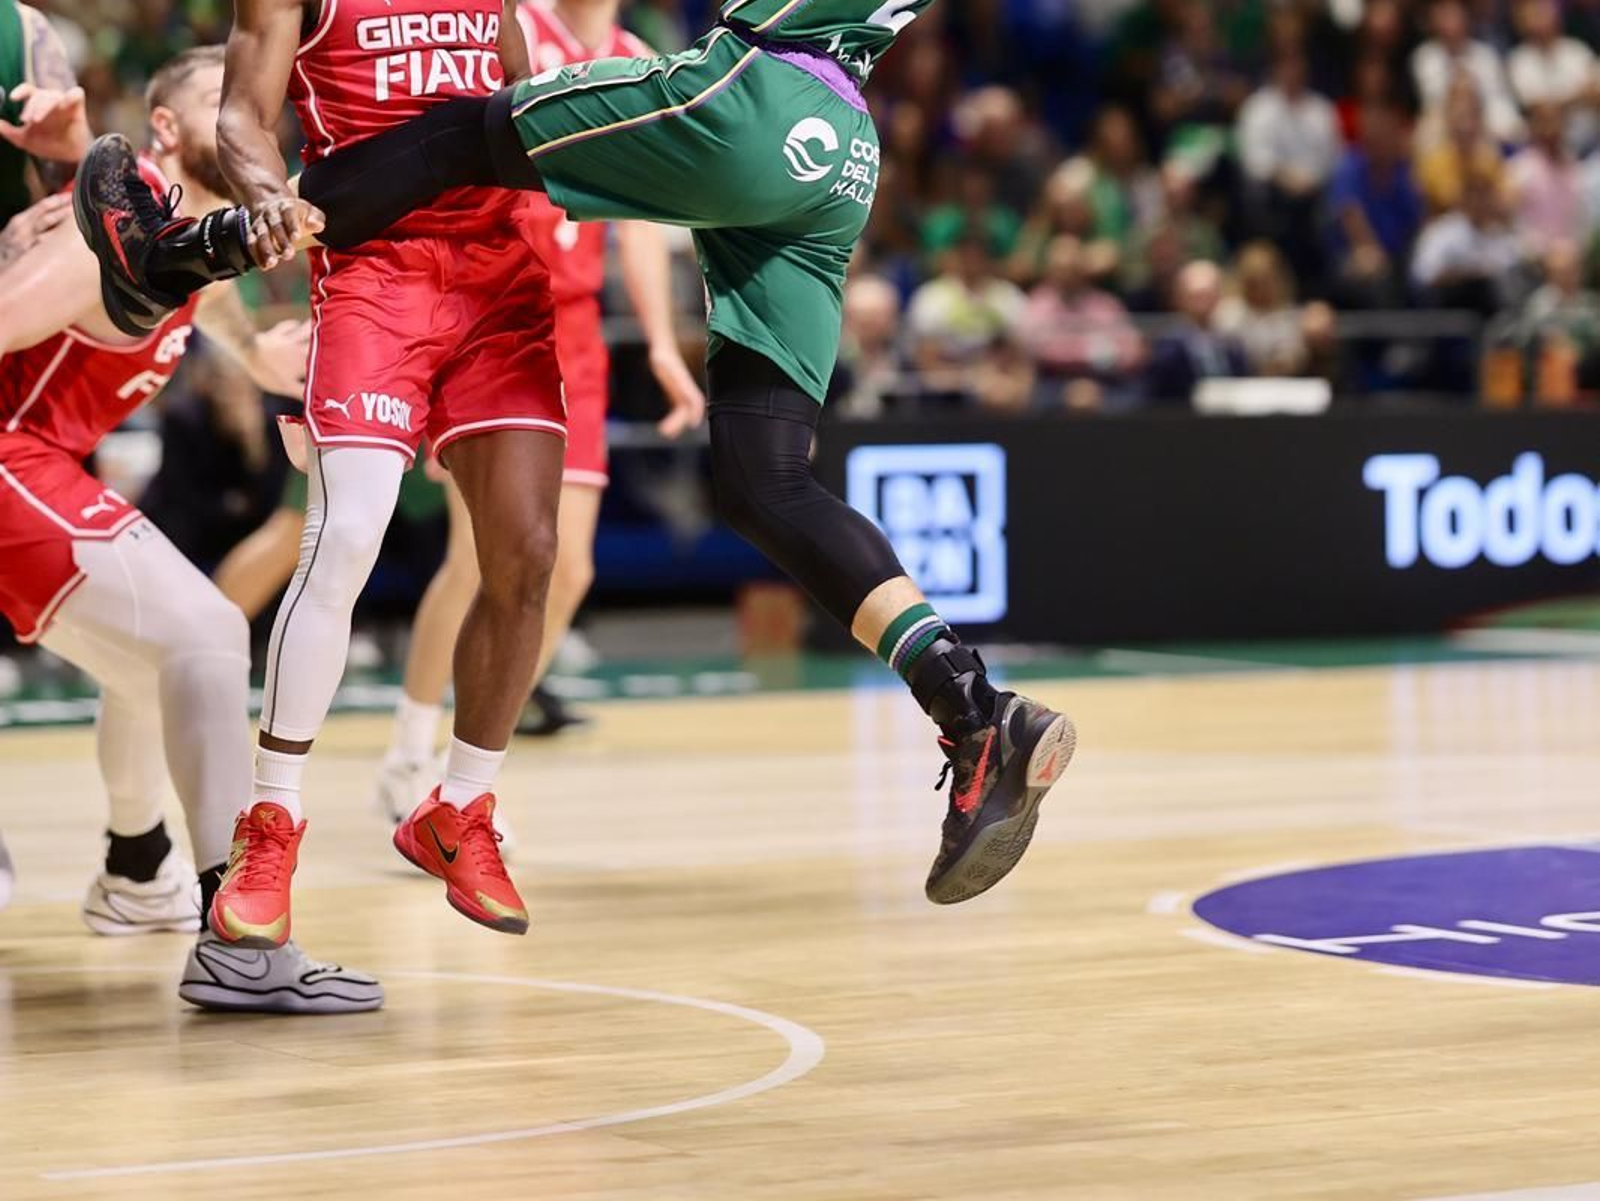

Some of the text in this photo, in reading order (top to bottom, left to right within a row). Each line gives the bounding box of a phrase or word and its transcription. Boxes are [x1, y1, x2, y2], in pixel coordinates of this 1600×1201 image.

[356, 12, 500, 50] GIRONA
[841, 160, 872, 184] DEL
[1362, 450, 1600, 570] Todo
